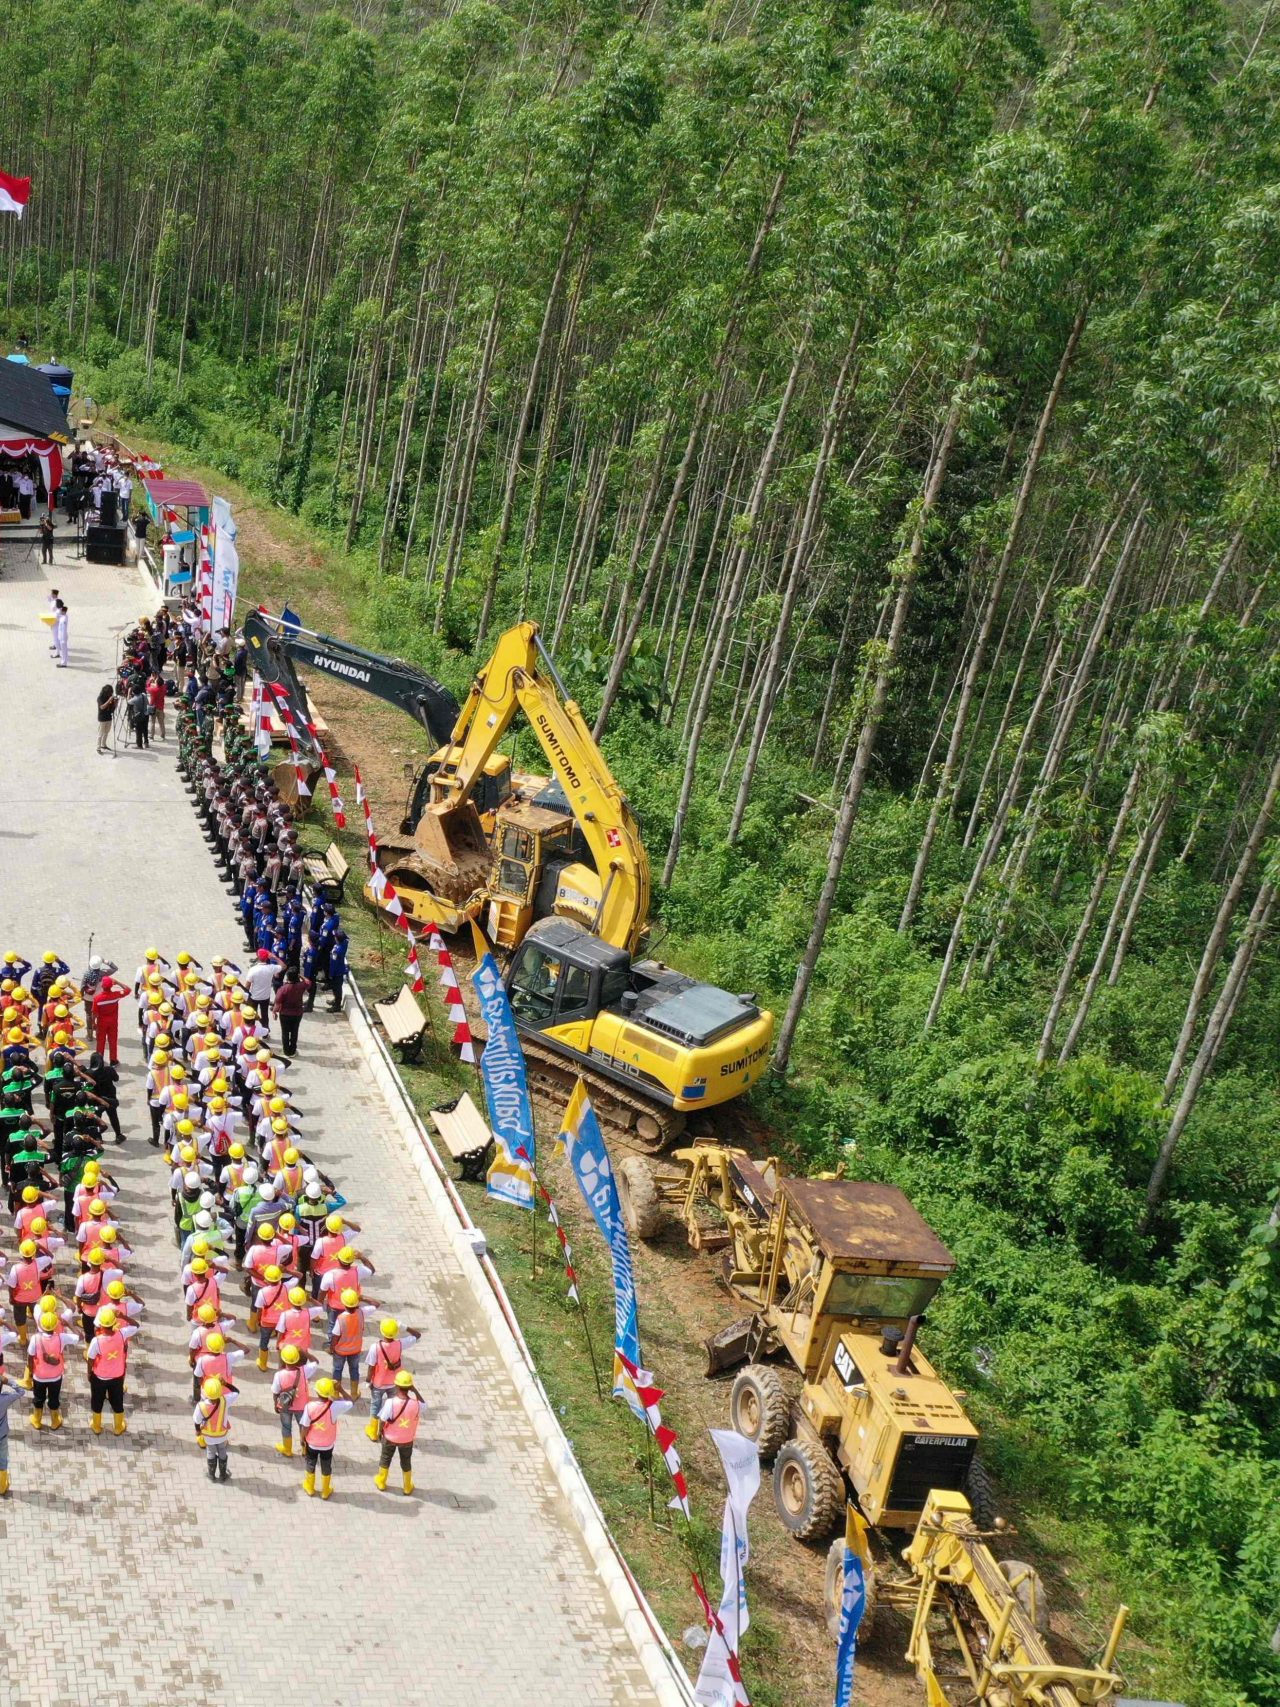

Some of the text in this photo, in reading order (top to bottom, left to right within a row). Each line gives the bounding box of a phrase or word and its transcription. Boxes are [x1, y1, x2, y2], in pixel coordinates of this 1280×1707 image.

[313, 655, 371, 683] HYUNDAI
[536, 714, 581, 790] SUMITOMO
[590, 1048, 640, 1078] SH210
[719, 1043, 770, 1077] SUMITOMO
[833, 1341, 857, 1383] CAT
[914, 1435, 968, 1447] CATERPILLAR
